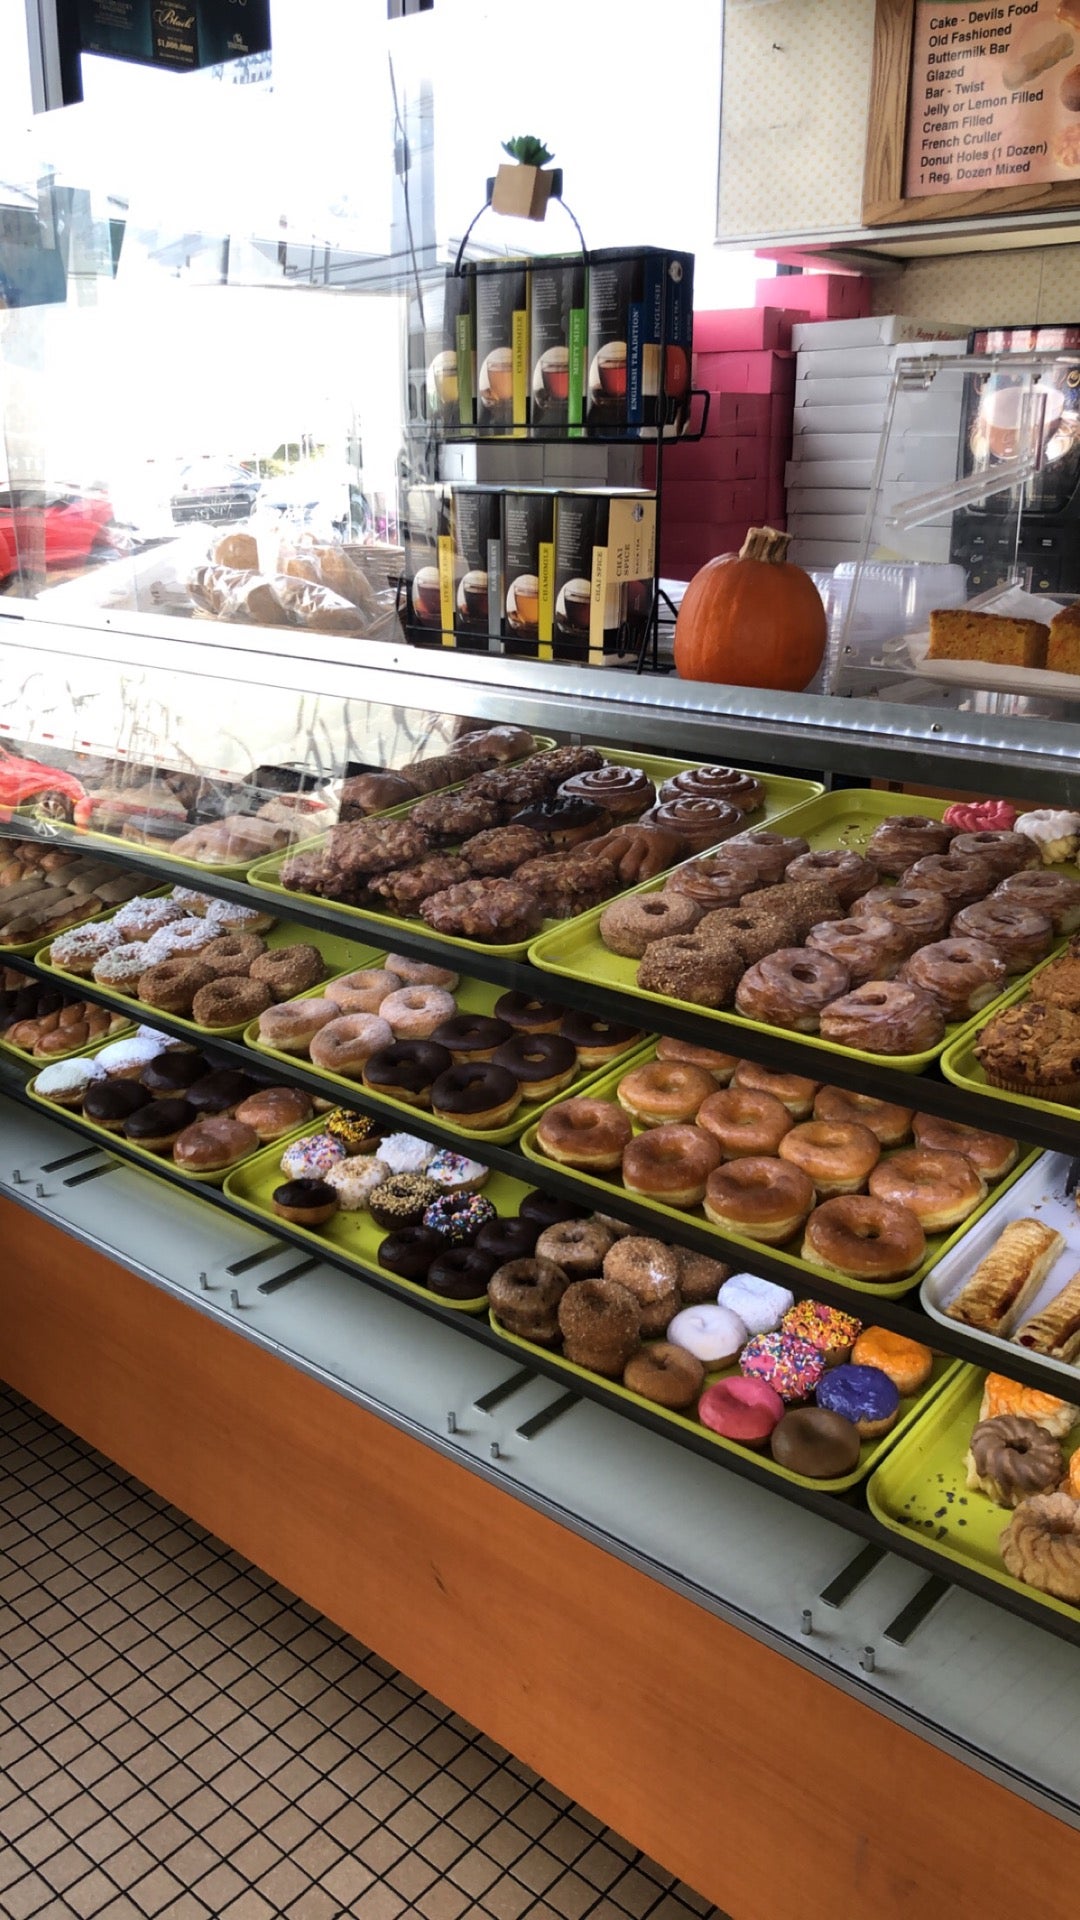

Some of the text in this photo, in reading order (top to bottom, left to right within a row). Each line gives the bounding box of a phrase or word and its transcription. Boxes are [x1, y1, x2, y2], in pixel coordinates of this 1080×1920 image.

[930, 16, 958, 30] Cake
[968, 8, 1004, 23] Devils
[1007, 1, 1038, 16] Food
[929, 24, 1012, 48] Old Fashioned
[928, 42, 1010, 65] Buttermilk Bar
[927, 66, 964, 82] Glazed
[925, 87, 944, 99] Bar
[955, 80, 985, 95] Twist
[924, 89, 1044, 117] Jelly or Lemon Filled
[923, 113, 993, 134] Cream Filled
[922, 131, 1003, 151] French Cruller
[921, 141, 1048, 168] Donut Holes (1 Dozen)
[920, 161, 1031, 185] 1 Reg. Dozen Mixed
[573, 346, 581, 376] MISTY
